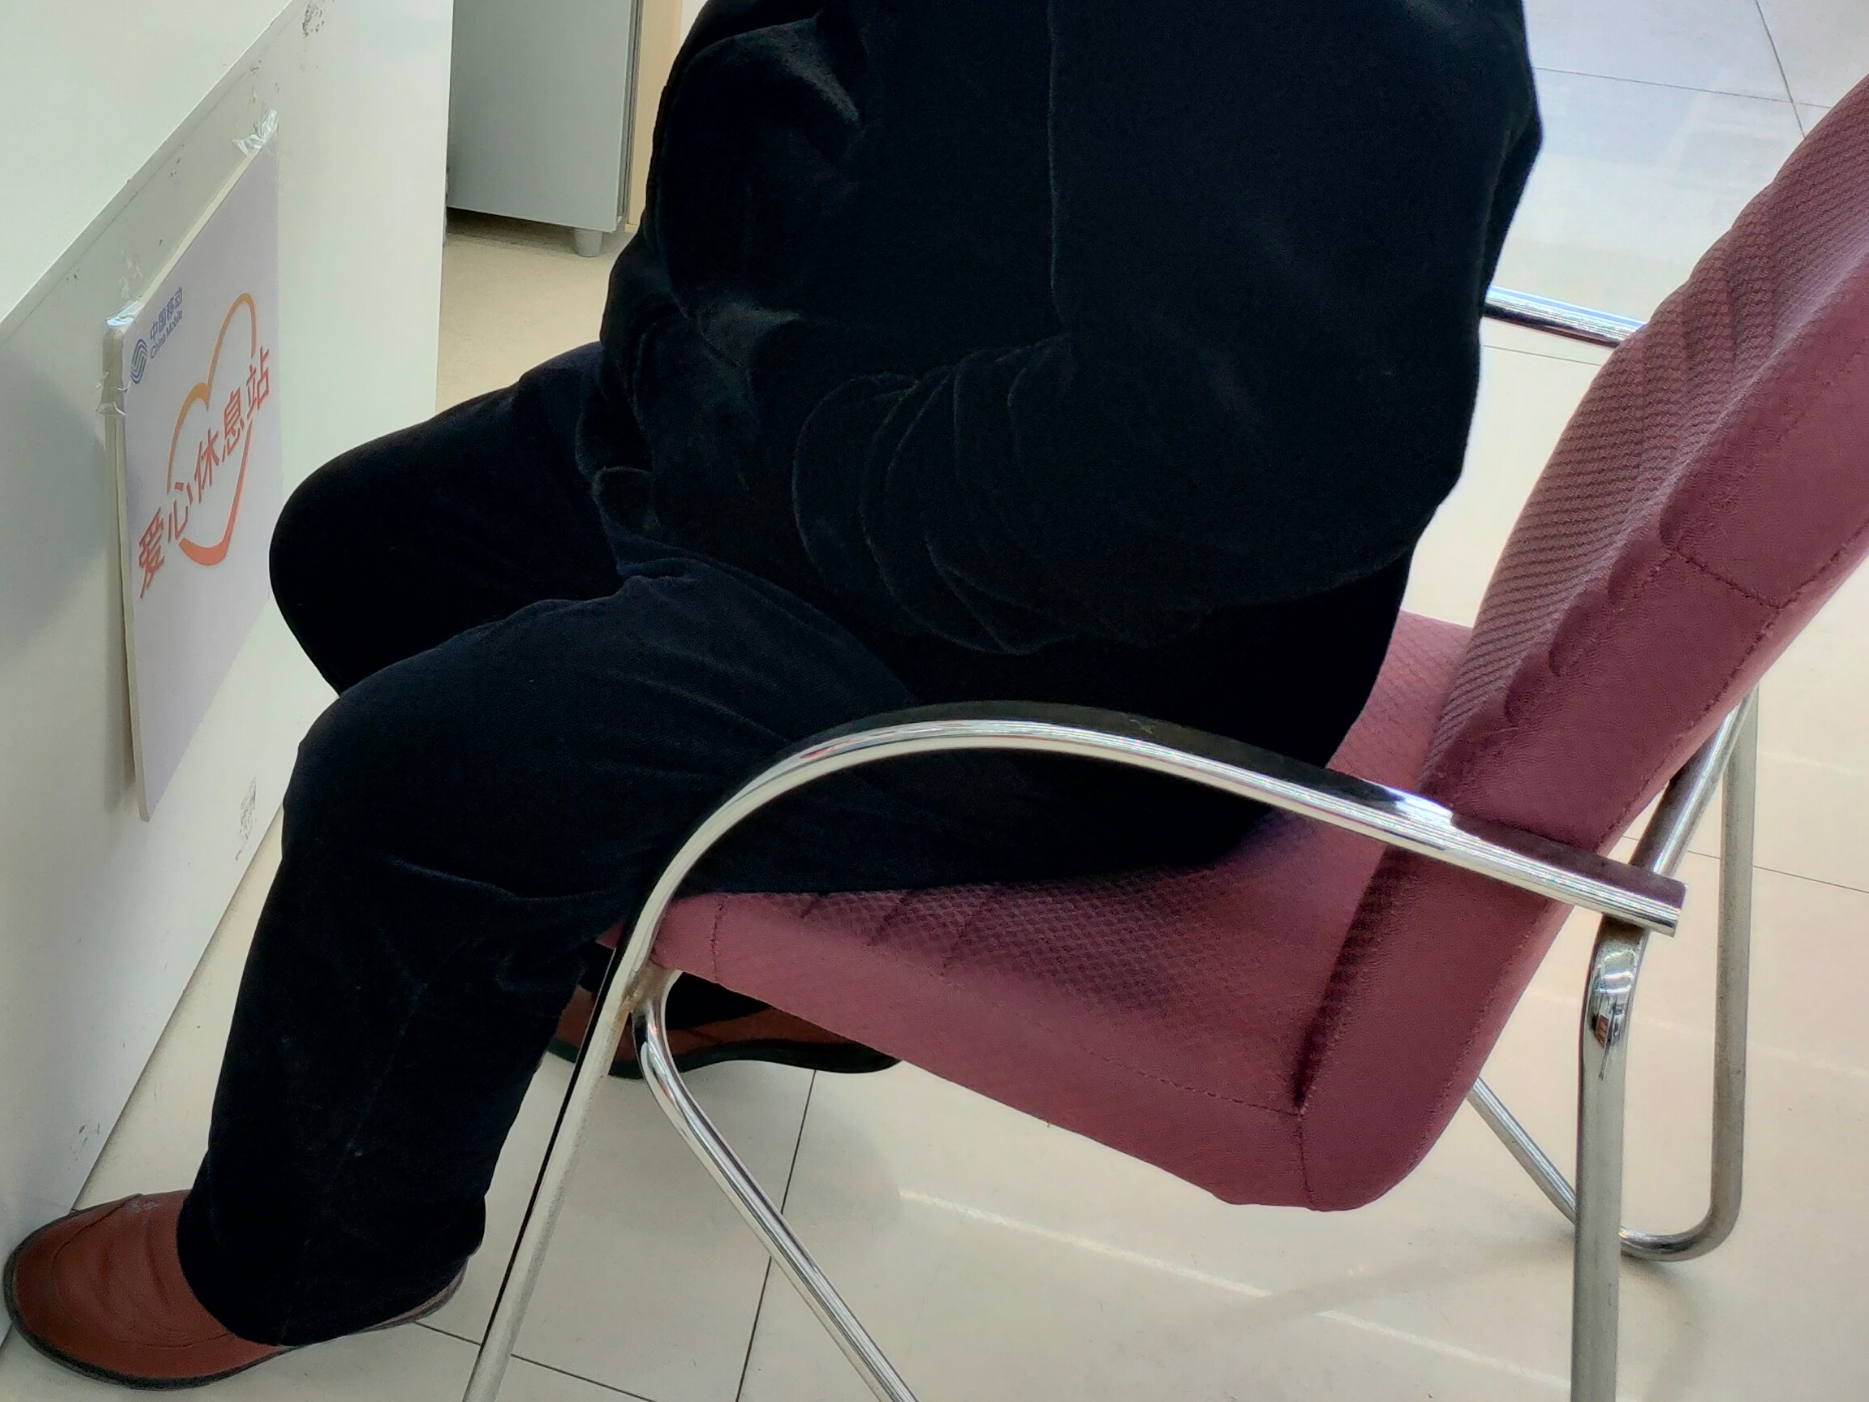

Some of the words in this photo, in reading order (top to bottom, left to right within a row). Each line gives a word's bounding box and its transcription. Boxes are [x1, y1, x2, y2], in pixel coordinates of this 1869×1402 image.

[149, 285, 183, 342] 中国移动
[150, 334, 166, 359] China
[138, 345, 271, 600] 爱心休息站
